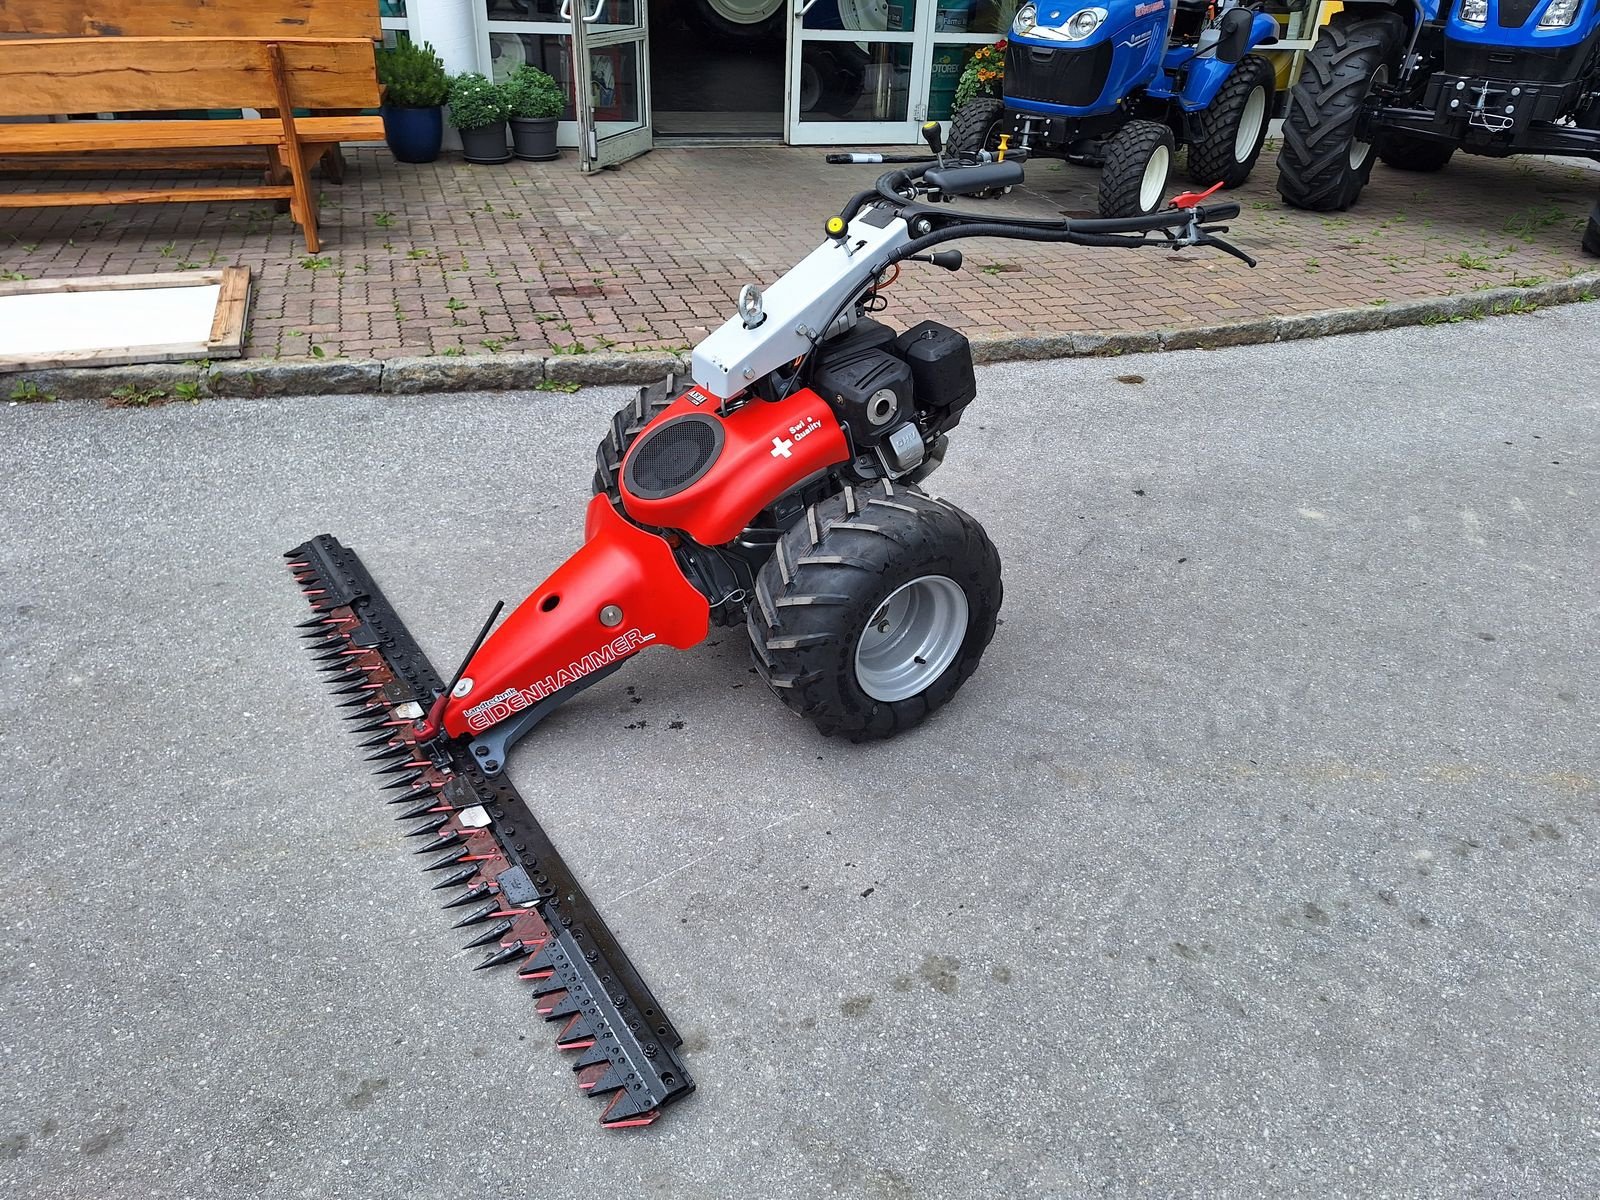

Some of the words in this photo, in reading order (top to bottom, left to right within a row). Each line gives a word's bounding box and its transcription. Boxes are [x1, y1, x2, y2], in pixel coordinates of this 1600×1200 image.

[931, 63, 962, 73] OTOREX
[794, 419, 821, 441] Quality
[467, 628, 645, 731] EIDENHAMMER
[463, 687, 518, 717] Landtechnik
